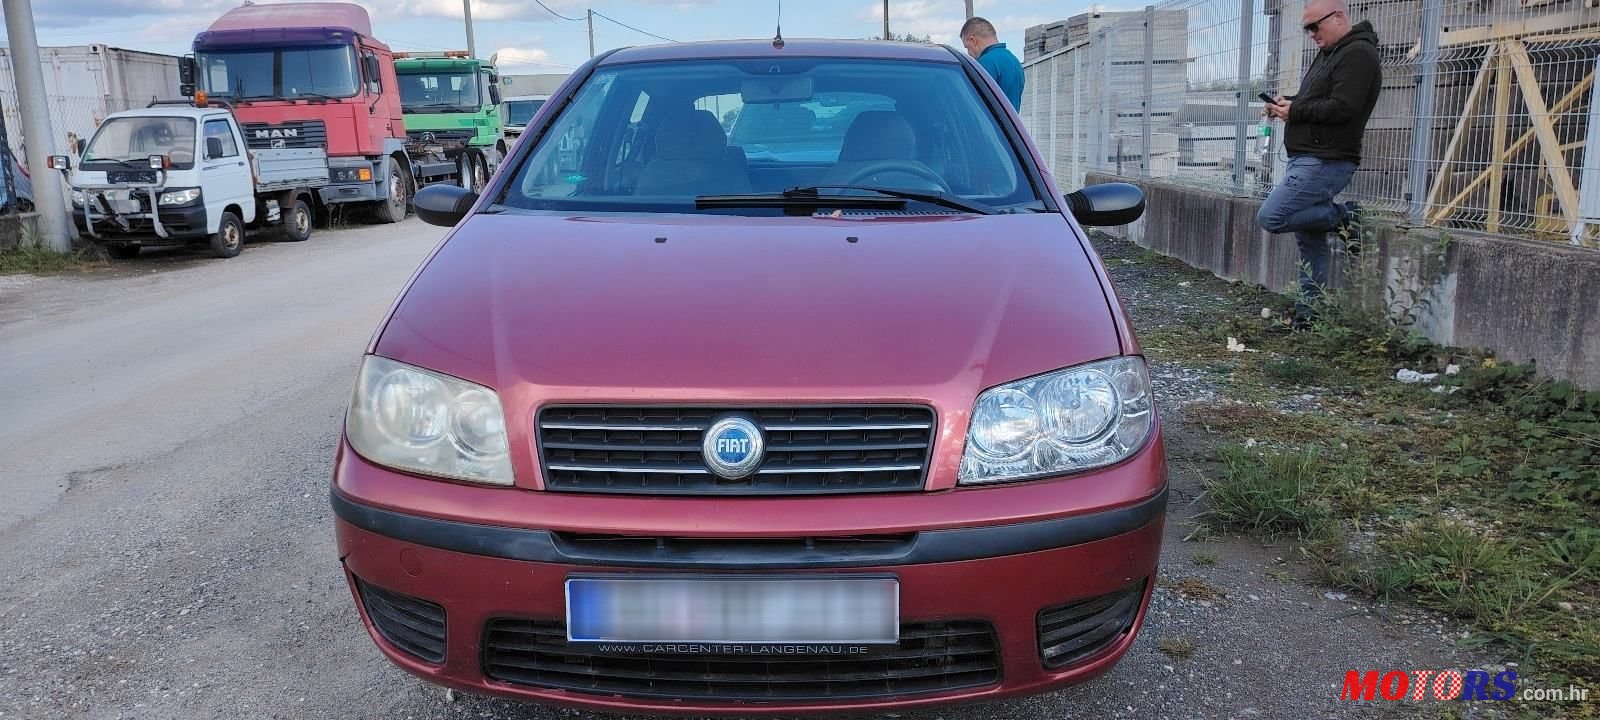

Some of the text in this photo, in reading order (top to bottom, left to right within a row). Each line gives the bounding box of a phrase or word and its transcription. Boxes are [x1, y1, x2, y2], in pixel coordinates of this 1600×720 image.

[255, 128, 298, 139] MAN
[717, 438, 749, 453] FIAT
[598, 643, 868, 655] WWW.CARCENTER-LANGENAU.DE
